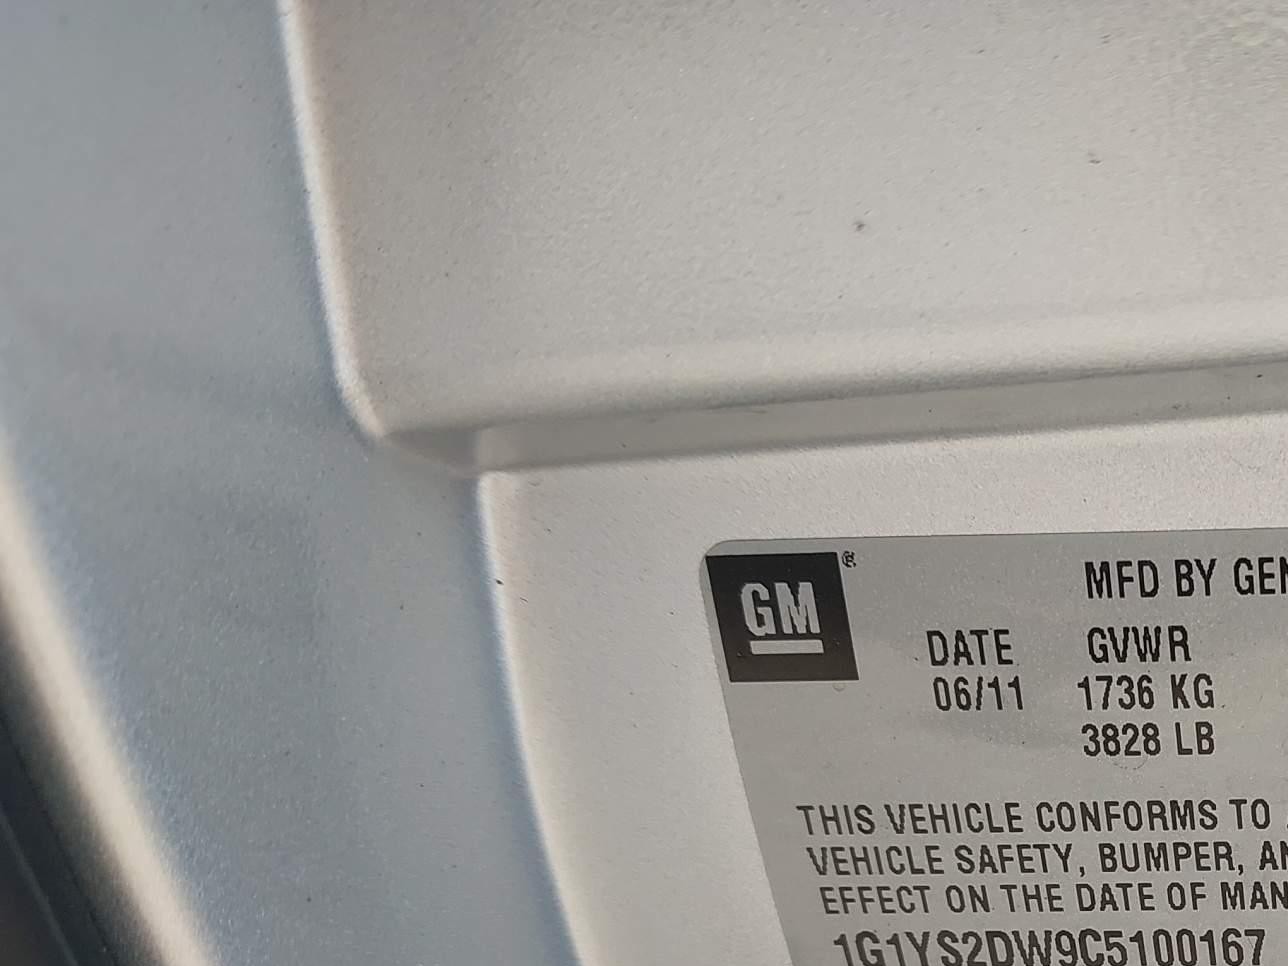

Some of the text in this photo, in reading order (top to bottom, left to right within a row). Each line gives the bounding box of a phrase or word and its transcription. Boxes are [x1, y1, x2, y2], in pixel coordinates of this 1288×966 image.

[1084, 559, 1160, 600] MFD
[1174, 558, 1218, 597] BY
[739, 581, 821, 637] GM
[926, 628, 1014, 667] DATE
[1086, 624, 1192, 664] GVWR
[932, 675, 1024, 712] 06/11
[1077, 672, 1215, 711] 1736 KG
[1081, 721, 1215, 757] 3828 LB
[795, 804, 876, 836] THIS
[883, 802, 1024, 835] VEHICLE
[1035, 799, 1218, 833] CONFORMS
[1228, 798, 1271, 830] TO
[805, 845, 945, 876] VEHICLE
[954, 843, 1086, 878] SAFETY,
[1098, 841, 1244, 876] BUMPER,
[819, 885, 931, 915] EFFECT
[945, 884, 991, 914] ON
[999, 883, 1065, 913] THE
[1075, 882, 1156, 912] DATE
[1166, 881, 1207, 911] OF
